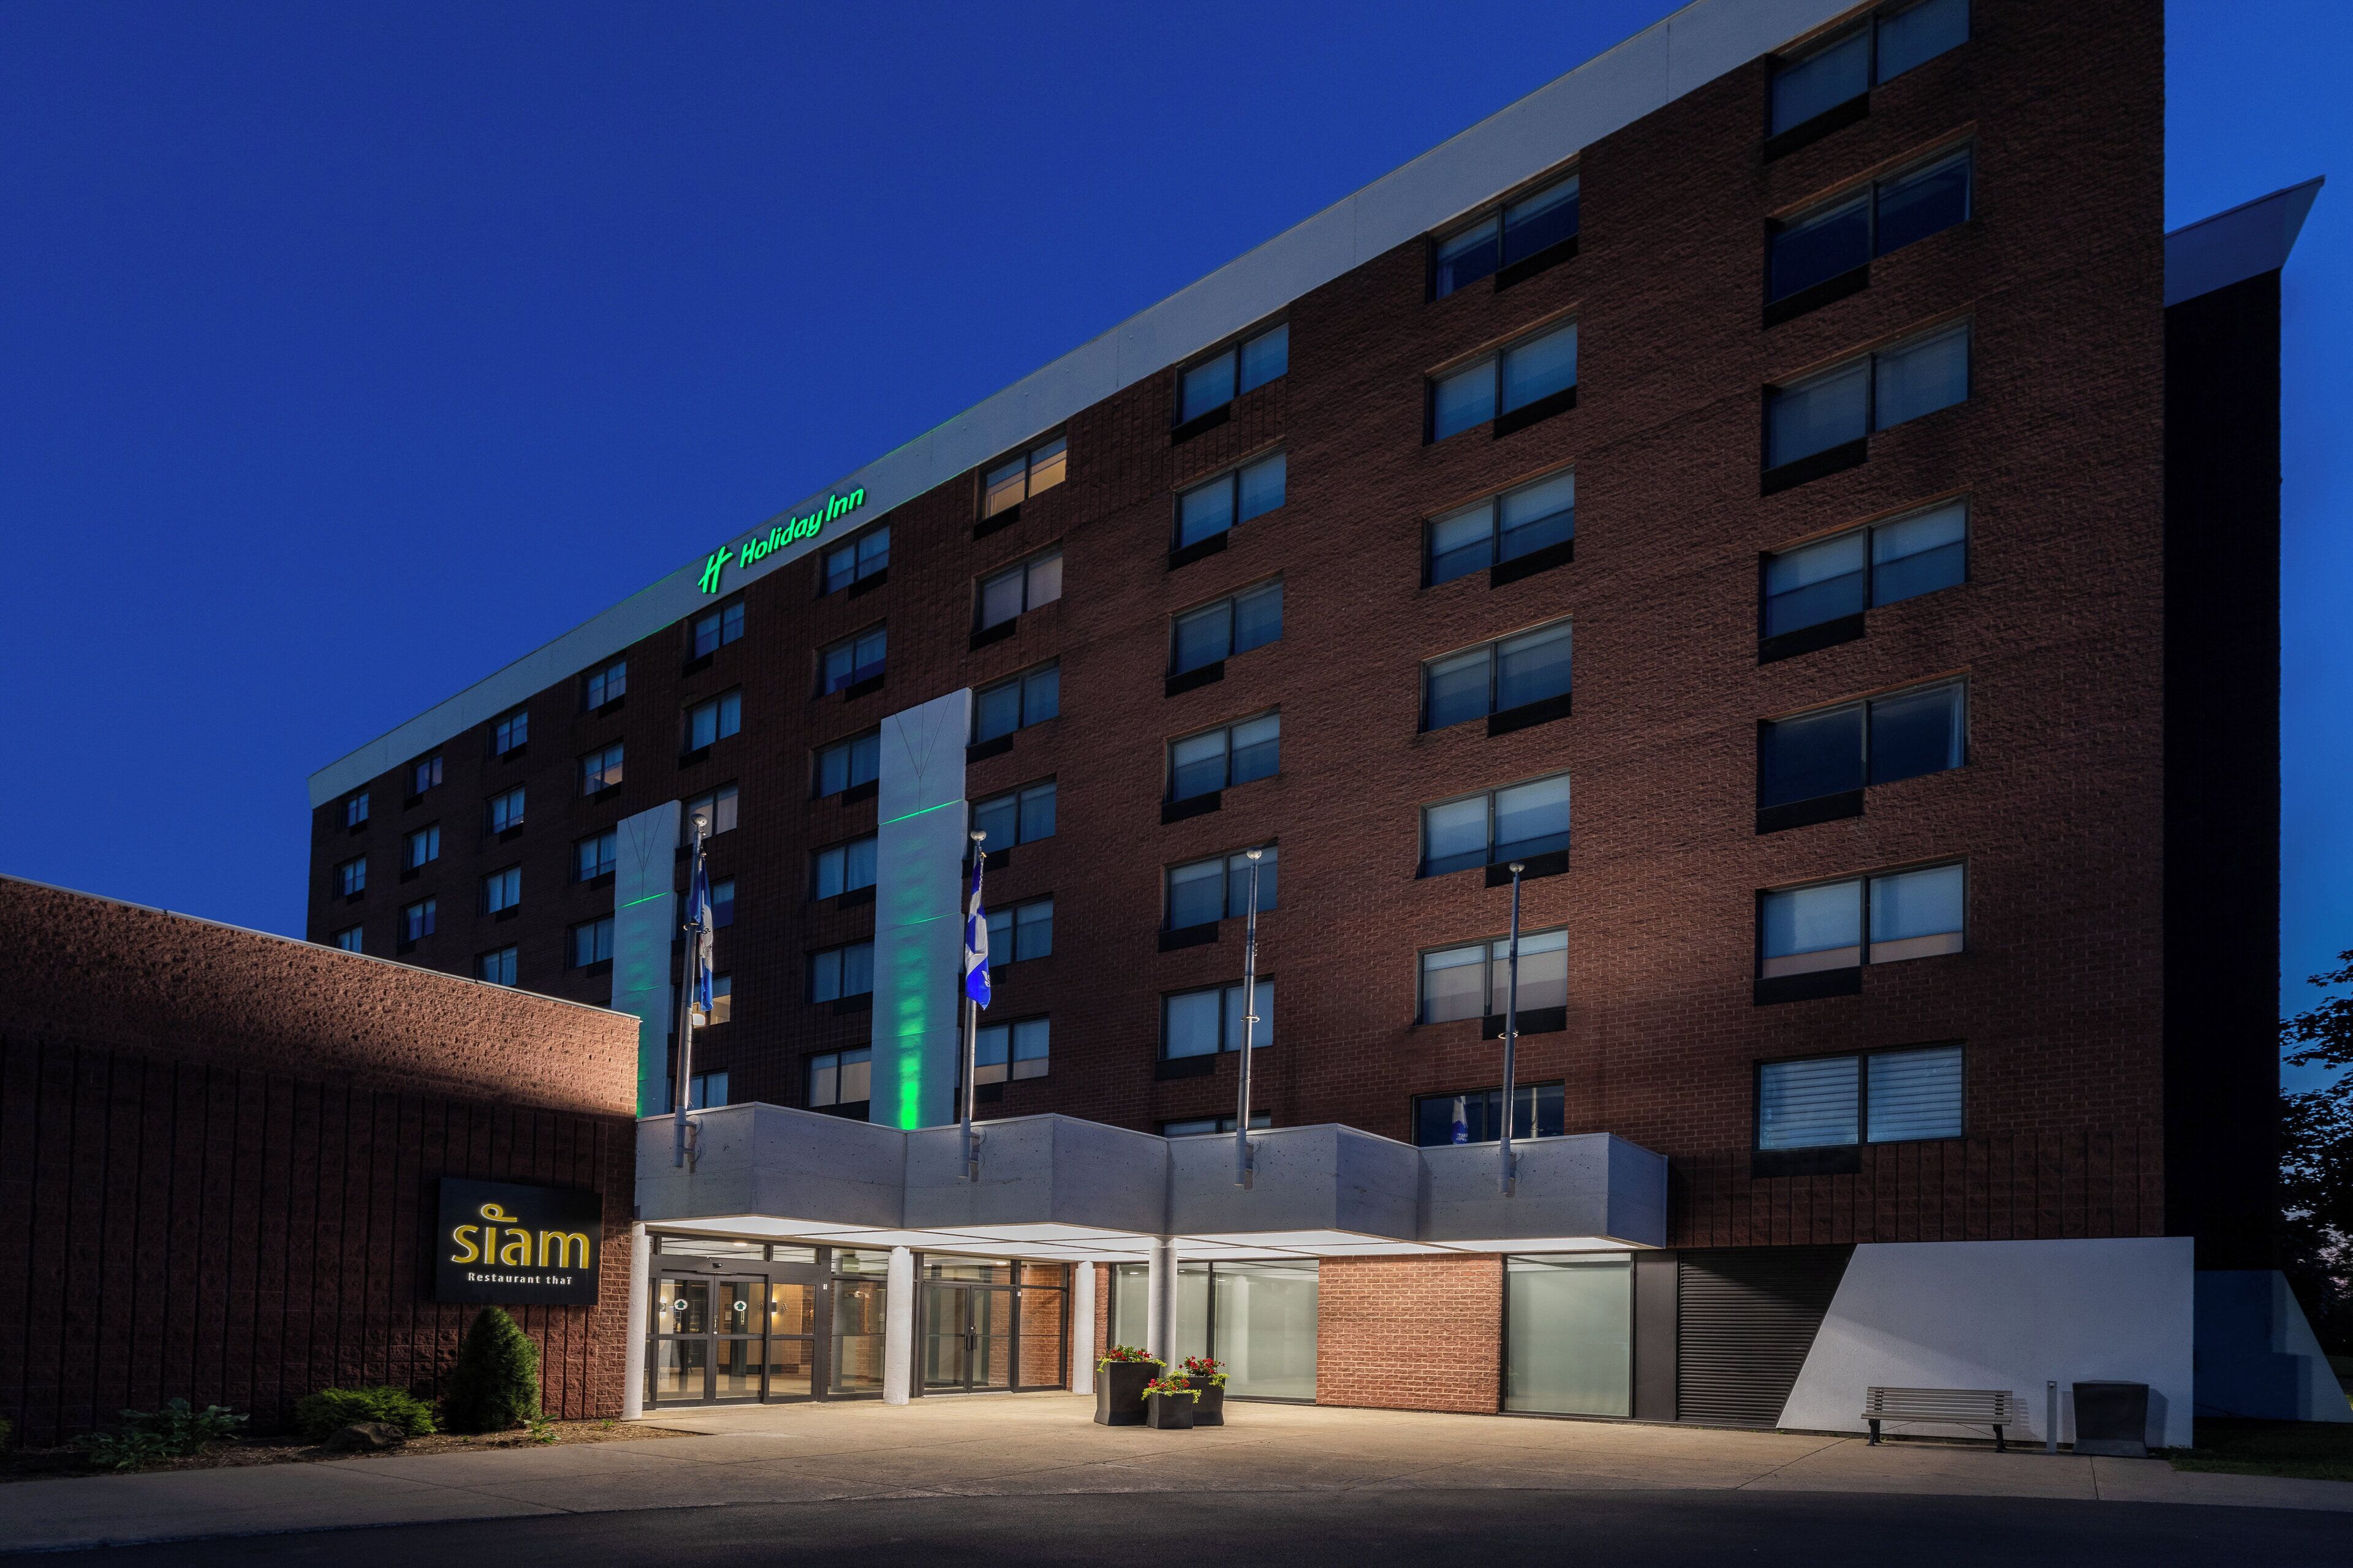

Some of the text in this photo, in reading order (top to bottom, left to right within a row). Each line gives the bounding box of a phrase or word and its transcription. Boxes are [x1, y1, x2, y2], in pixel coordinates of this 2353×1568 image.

[739, 509, 824, 568] Holiday
[825, 488, 864, 521] Inn
[451, 1203, 590, 1269] siam
[468, 1272, 572, 1285] Restaurant thaï
